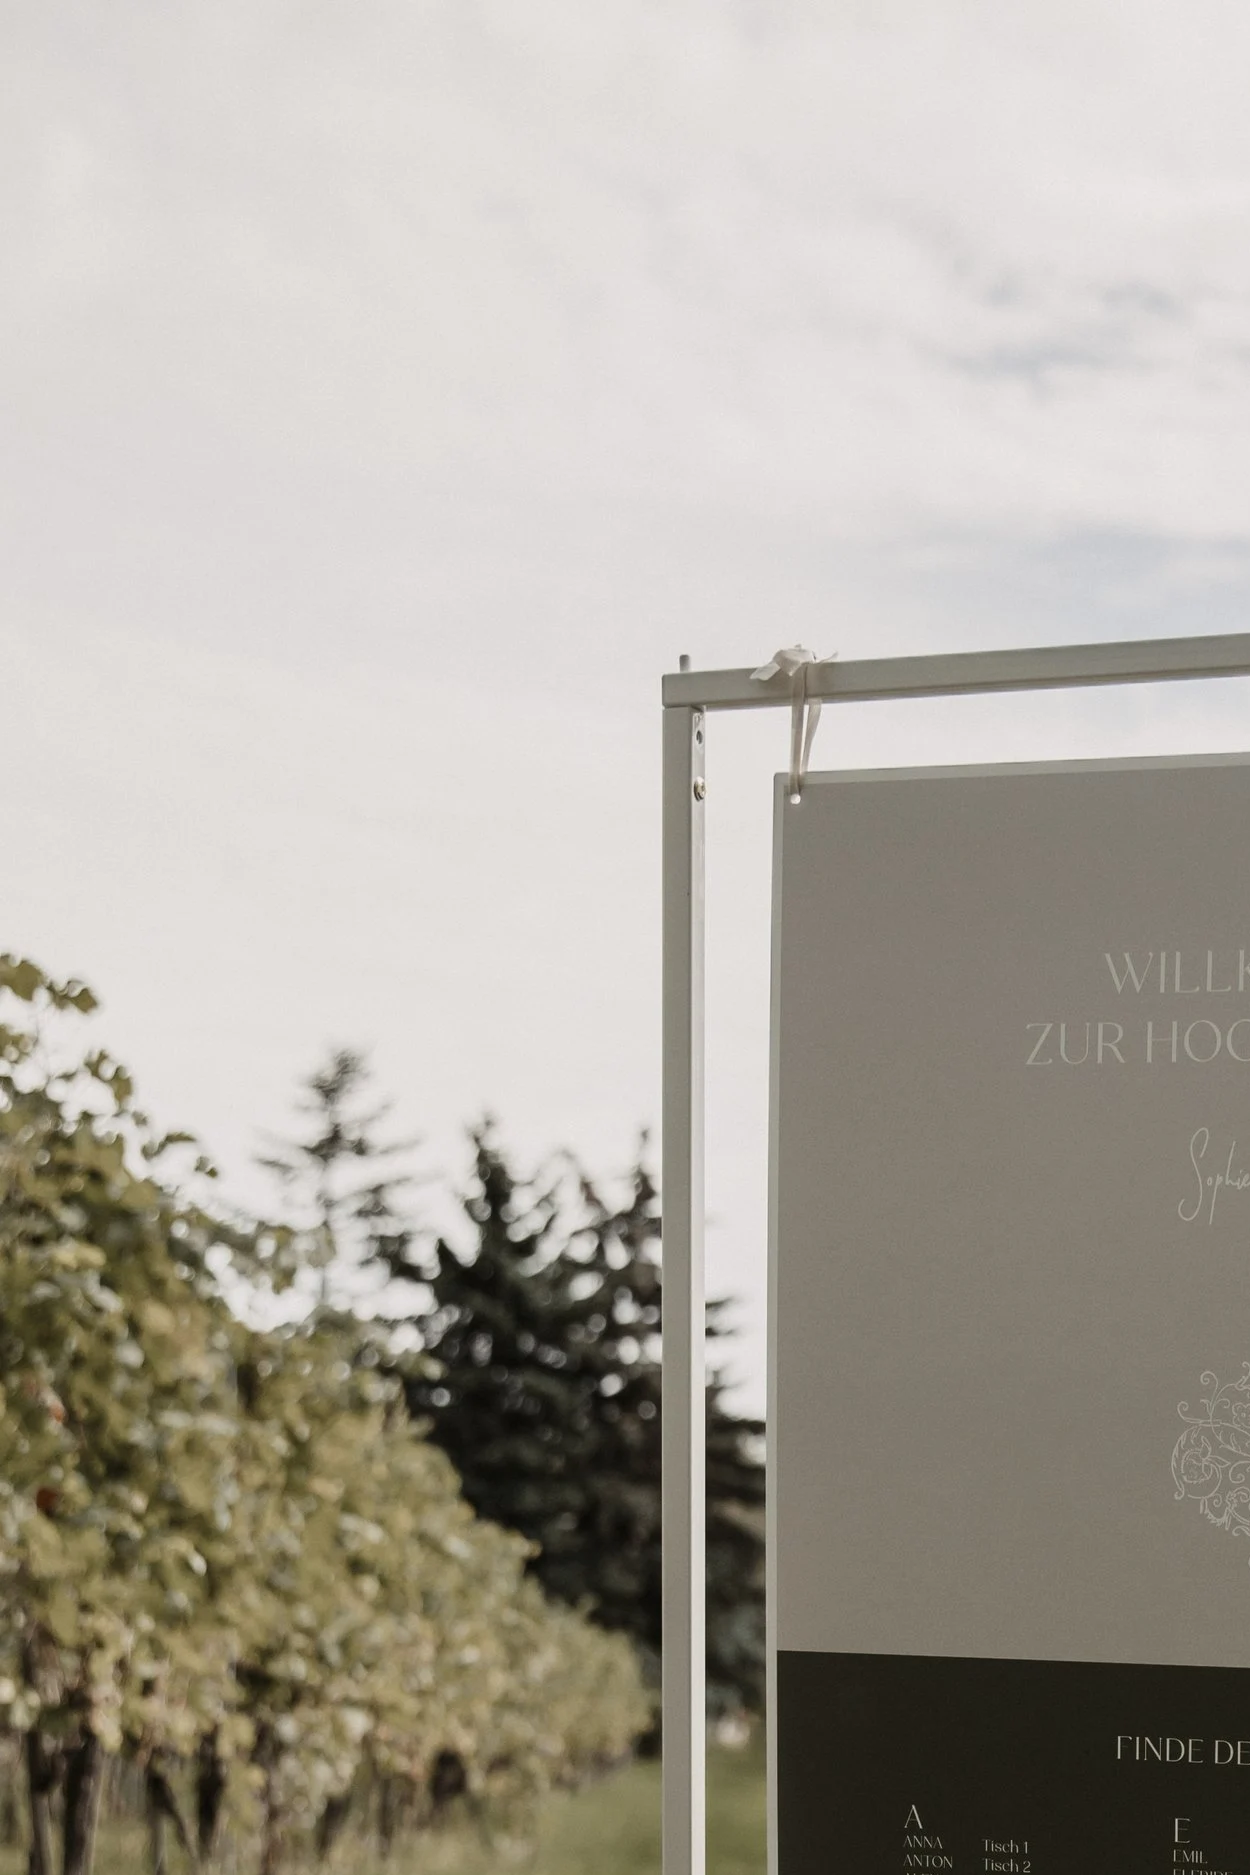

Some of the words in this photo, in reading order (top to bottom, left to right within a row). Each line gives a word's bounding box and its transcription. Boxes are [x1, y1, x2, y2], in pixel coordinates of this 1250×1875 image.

[1025, 1021, 1125, 1065] ZUR
[1116, 1736, 1204, 1764] FINDE
[904, 1804, 923, 1829] A
[1174, 1818, 1191, 1843] E
[903, 1835, 943, 1849] ANNA
[983, 1839, 1019, 1854] Tisch
[1023, 1841, 1029, 1854] 1
[1173, 1850, 1207, 1864] EMIL
[903, 1854, 953, 1869] ANTON
[983, 1858, 1019, 1873] Tisch
[1022, 1861, 1031, 1873] 2
